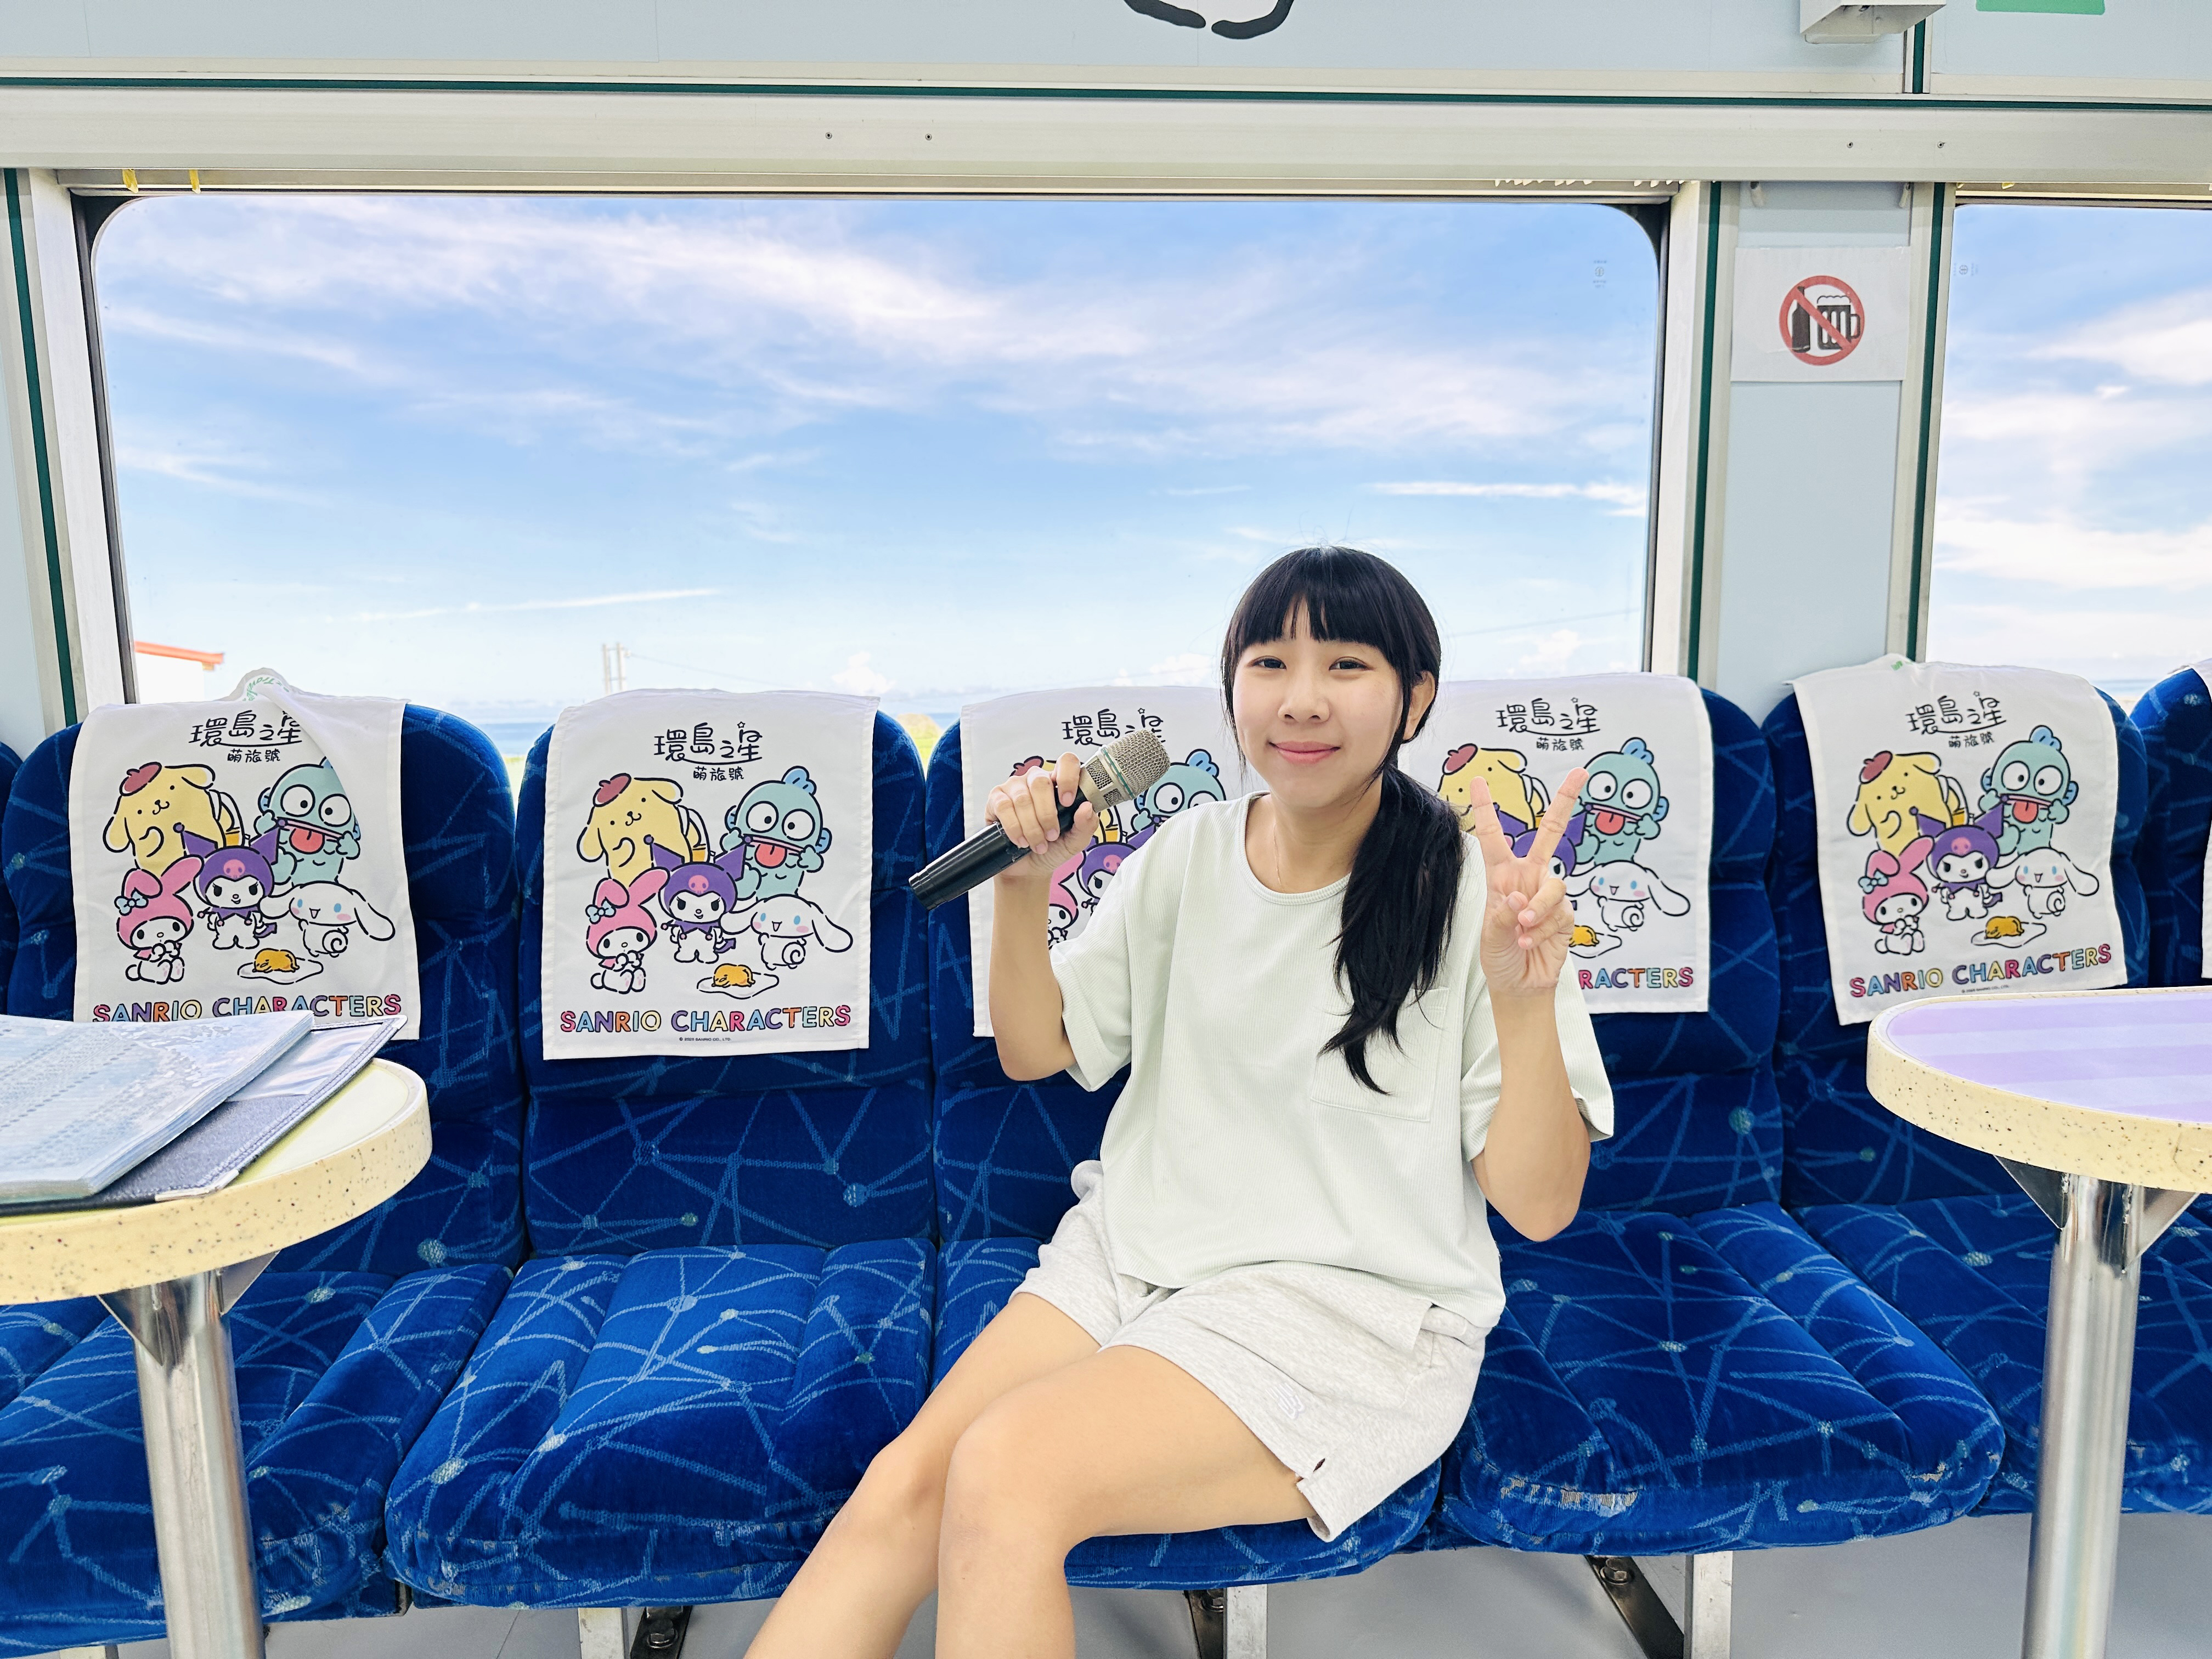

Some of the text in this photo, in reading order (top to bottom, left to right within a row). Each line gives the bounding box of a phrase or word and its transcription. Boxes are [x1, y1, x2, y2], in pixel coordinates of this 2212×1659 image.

[1496, 697, 1601, 736] 環島之星
[1905, 691, 2007, 735] 環島之星
[188, 710, 303, 747] 環島之星
[1949, 731, 1995, 748] 萌旅號
[227, 748, 281, 763] 萌旅號
[653, 721, 763, 765] 環島之星
[1536, 737, 1584, 751] 萌旅號
[693, 766, 744, 781] 萌旅號
[1578, 967, 1694, 989] RACTERS
[1849, 944, 2112, 998] SANRIO CHARACTERS
[92, 994, 402, 1022] SANRIO CHARACTERS
[560, 1005, 851, 1032] SANRIO CHARACTERS
